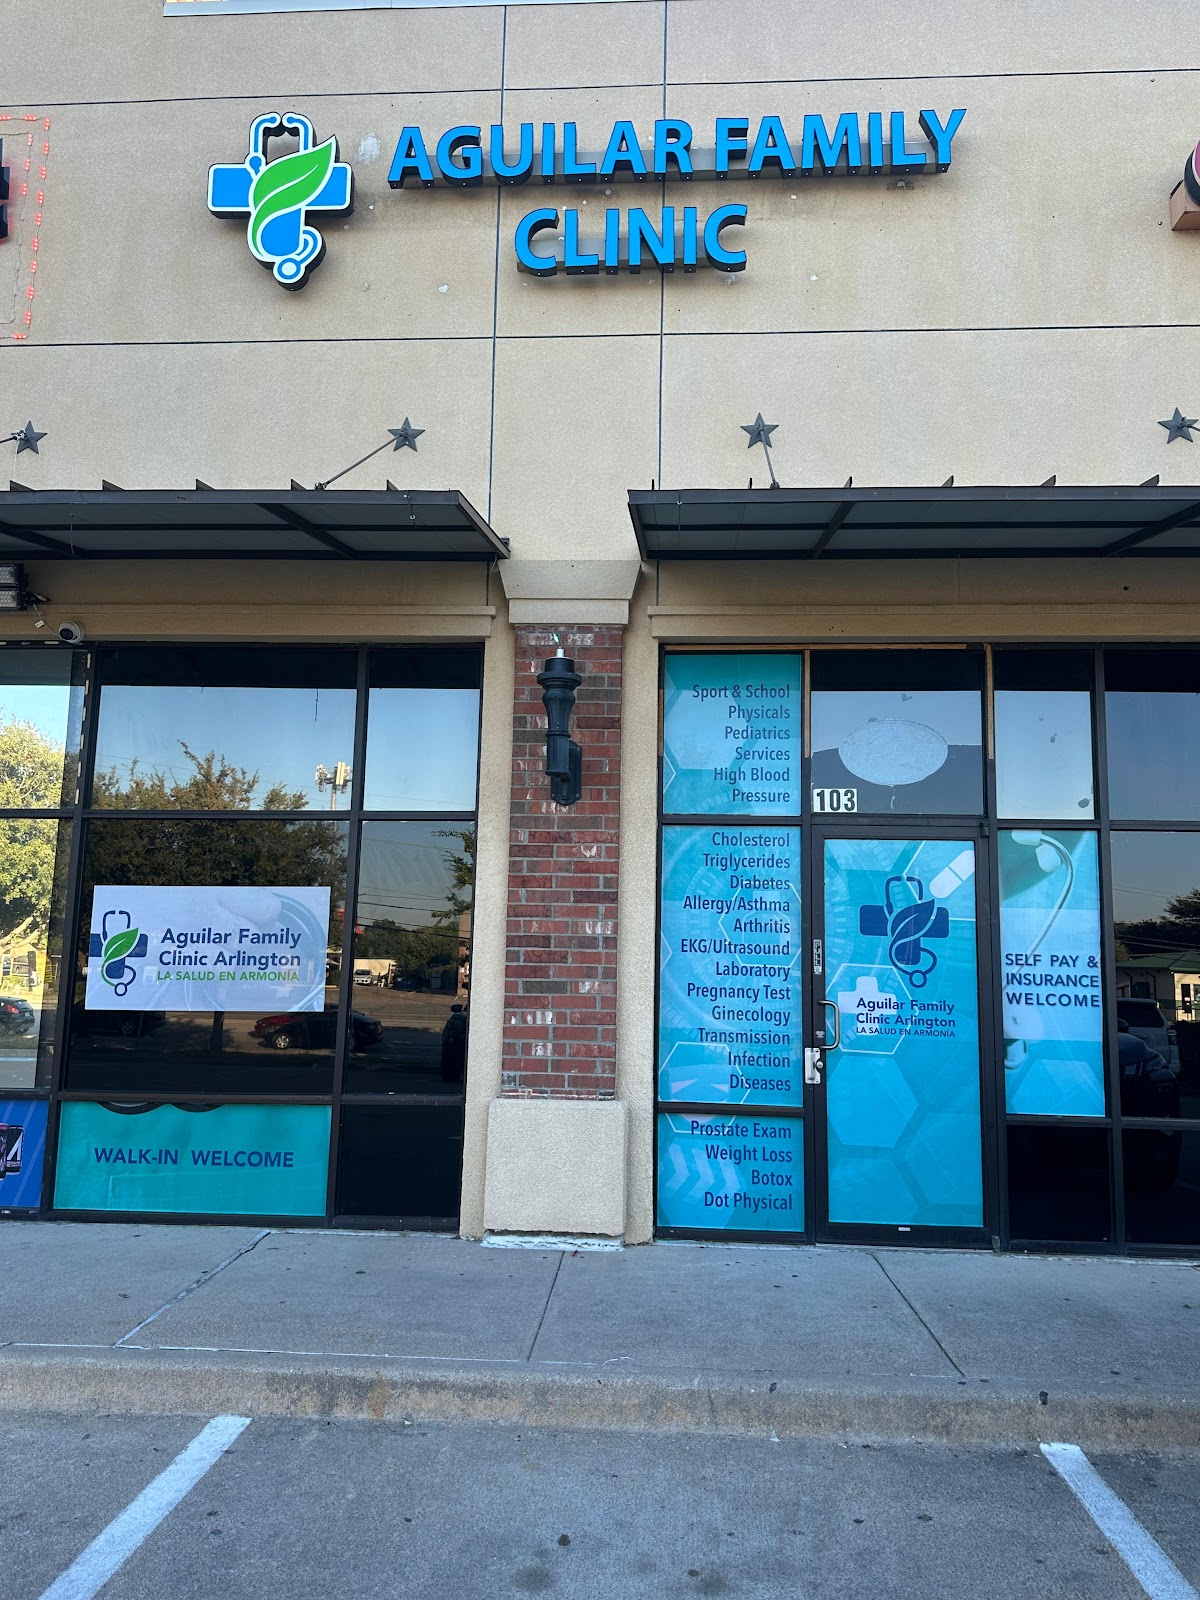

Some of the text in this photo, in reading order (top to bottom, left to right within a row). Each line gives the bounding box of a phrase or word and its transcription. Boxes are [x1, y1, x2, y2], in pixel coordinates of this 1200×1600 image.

[387, 108, 967, 186] AGUILAR FAMILY
[514, 203, 748, 271] CLINIC
[692, 684, 790, 702] Sport & School
[728, 704, 791, 722] Physicals
[724, 725, 791, 740] Pediatrics
[735, 746, 791, 761] Services
[713, 767, 790, 785] High Blood
[732, 788, 791, 803] Pressure
[815, 789, 856, 812] 103
[711, 831, 790, 848] Cholesterol
[703, 853, 791, 872] Triglycerides
[730, 874, 791, 890] Diabetes
[683, 895, 790, 915] Allergy/Asthma
[733, 918, 791, 934] Arthritis
[160, 927, 302, 949] Aguilar Family
[681, 938, 791, 956] EKG/Ultrasound
[159, 950, 301, 971] Clinic Arlington
[1005, 953, 1099, 969] SELF PAY &
[157, 969, 300, 982] LA SALUD EN ARMONÍA
[715, 960, 791, 982] Laboratory
[1005, 972, 1100, 989] INSURANCE
[687, 982, 791, 1003] Pregnancy Test
[1005, 991, 1101, 1008] WELCOME
[856, 997, 955, 1015] Aguilar Family
[711, 1005, 791, 1027] Ginecology
[855, 1012, 956, 1030] Clinic Arlington
[698, 1028, 791, 1045] Transmission
[856, 1026, 867, 1035] LA
[868, 1026, 897, 1036] SALUD
[899, 1028, 912, 1037] EN
[728, 1051, 791, 1068] Infection
[730, 1074, 791, 1091] Diseases
[690, 1120, 792, 1139] Prostate Exam
[94, 1147, 294, 1168] WALK-IN WELCOME
[705, 1144, 793, 1165] Weight Loss
[751, 1169, 793, 1186] Botox
[704, 1191, 793, 1213] Dot Physical
